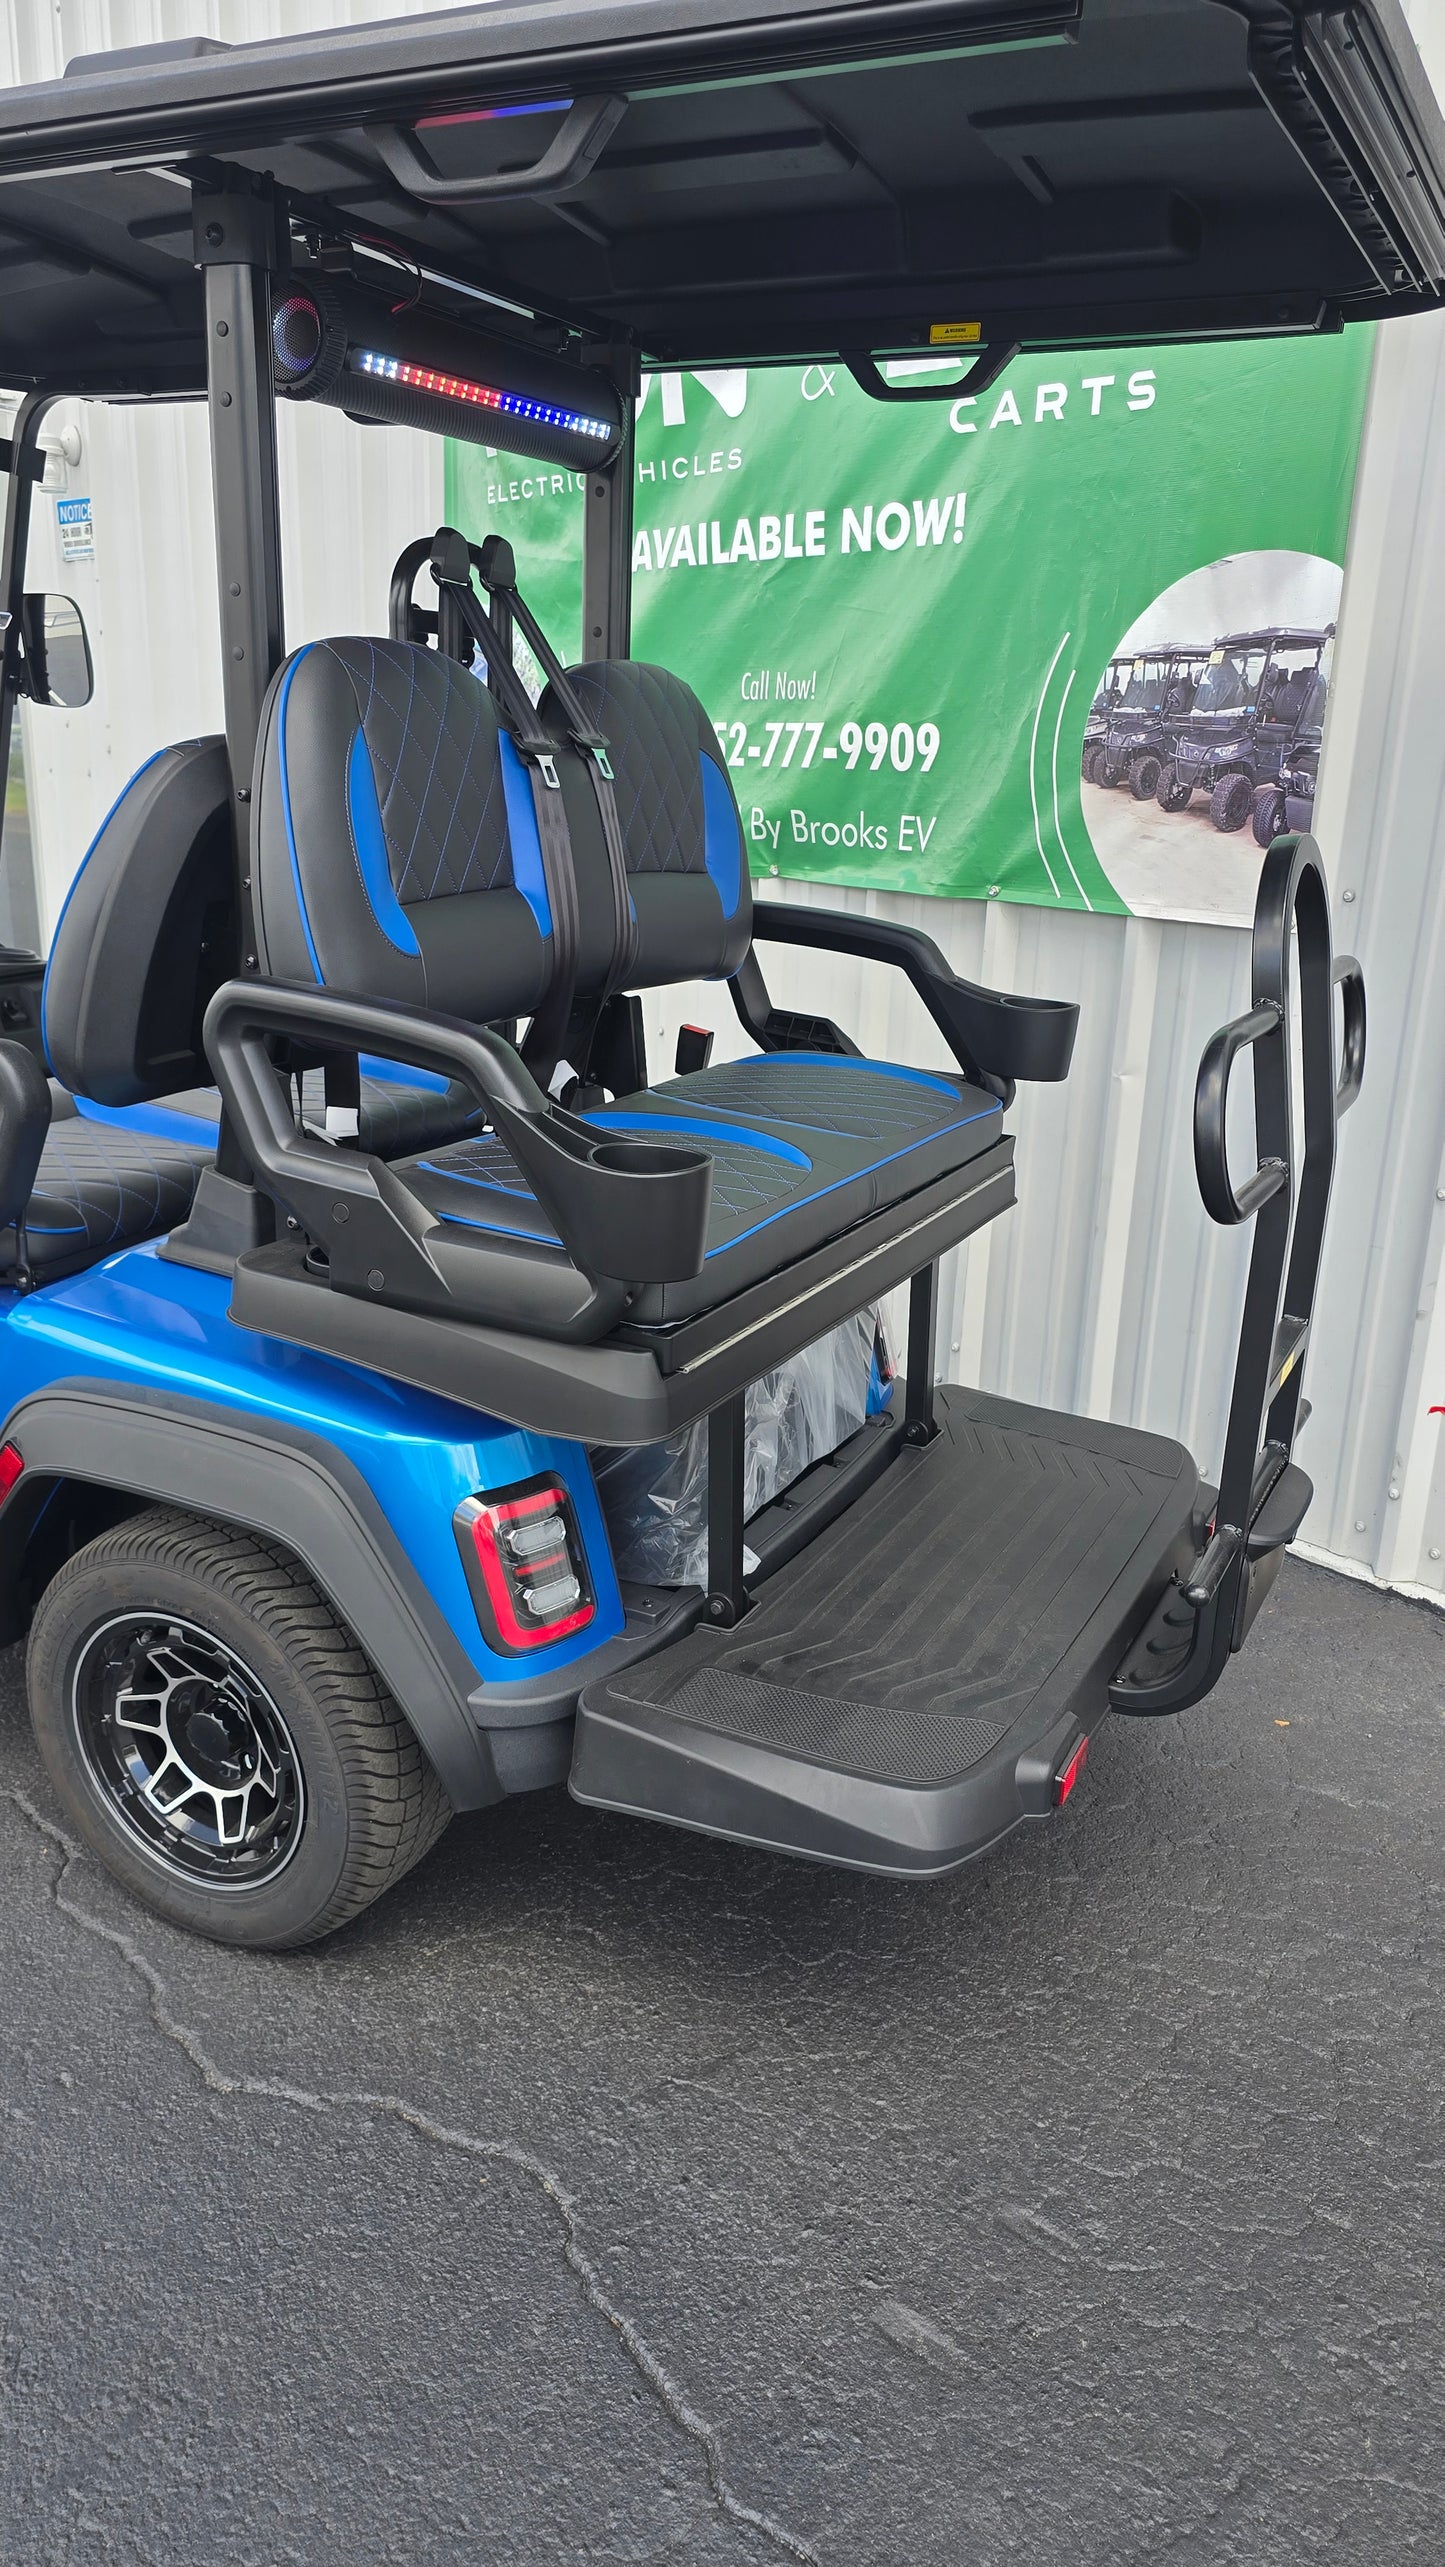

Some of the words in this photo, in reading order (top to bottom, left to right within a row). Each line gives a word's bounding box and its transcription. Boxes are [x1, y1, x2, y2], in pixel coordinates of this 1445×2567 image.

[949, 369, 1157, 434] CARTS
[487, 472, 586, 504] ELECTRIC
[638, 447, 742, 483] HICLES
[59, 503, 92, 522] NOTICE
[632, 510, 825, 573] AVAILABLE
[840, 492, 967, 554] NOW!
[741, 670, 769, 700] Call
[775, 670, 817, 701] Now!
[713, 721, 940, 772] 52-777-9909
[751, 807, 781, 850] By
[790, 808, 888, 850] Brooks
[898, 814, 937, 853] EV
